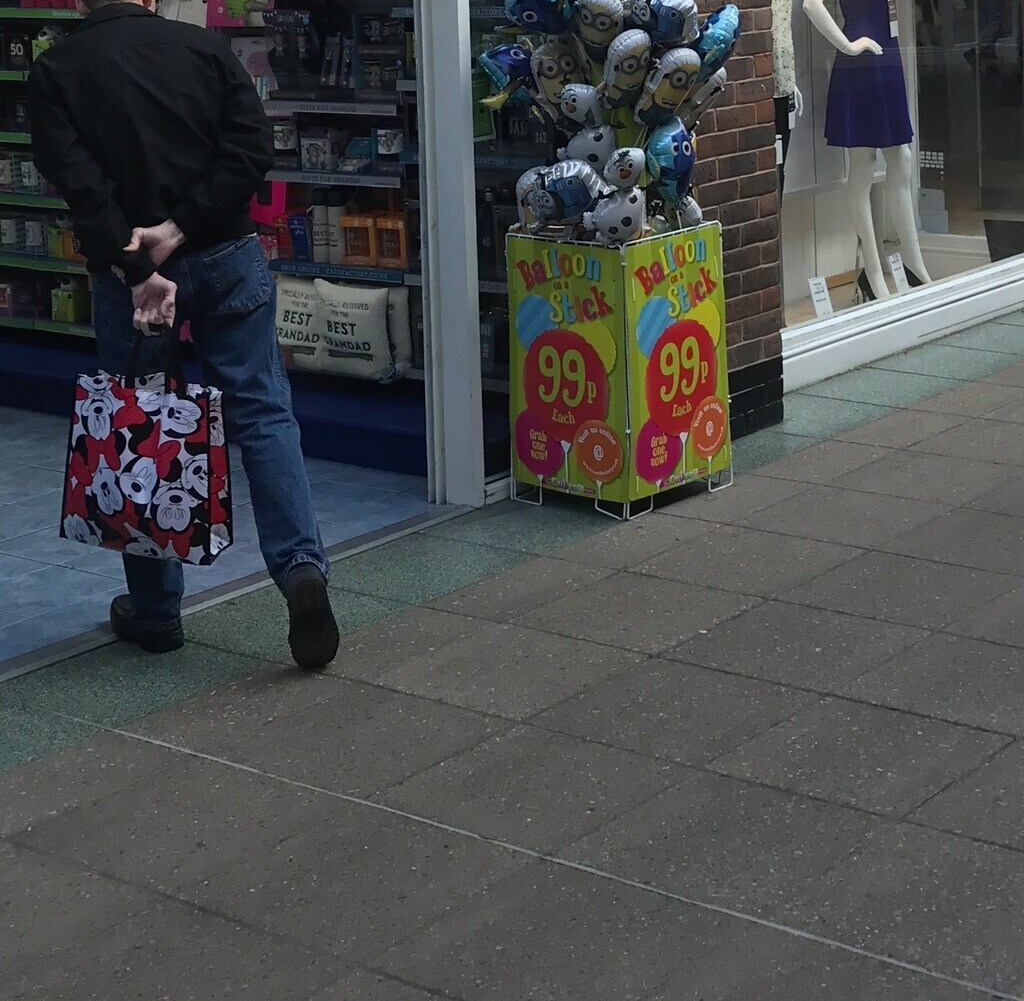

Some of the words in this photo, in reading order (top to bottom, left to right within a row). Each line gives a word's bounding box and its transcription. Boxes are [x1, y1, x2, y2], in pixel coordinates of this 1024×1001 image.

[516, 247, 601, 291] Balloon
[634, 238, 706, 296] Balloon
[668, 266, 718, 317] Stick
[549, 285, 613, 324] Stick
[283, 310, 313, 327] BEST
[326, 320, 357, 337] BEST
[323, 335, 372, 352] GRANDAD
[538, 345, 597, 408] 99p
[660, 336, 709, 403] 99p
[552, 408, 575, 425] Each
[672, 400, 693, 417] Each
[529, 428, 547, 442] Grab
[651, 435, 667, 448] Grab
[532, 441, 546, 451] one
[652, 446, 666, 457] one
